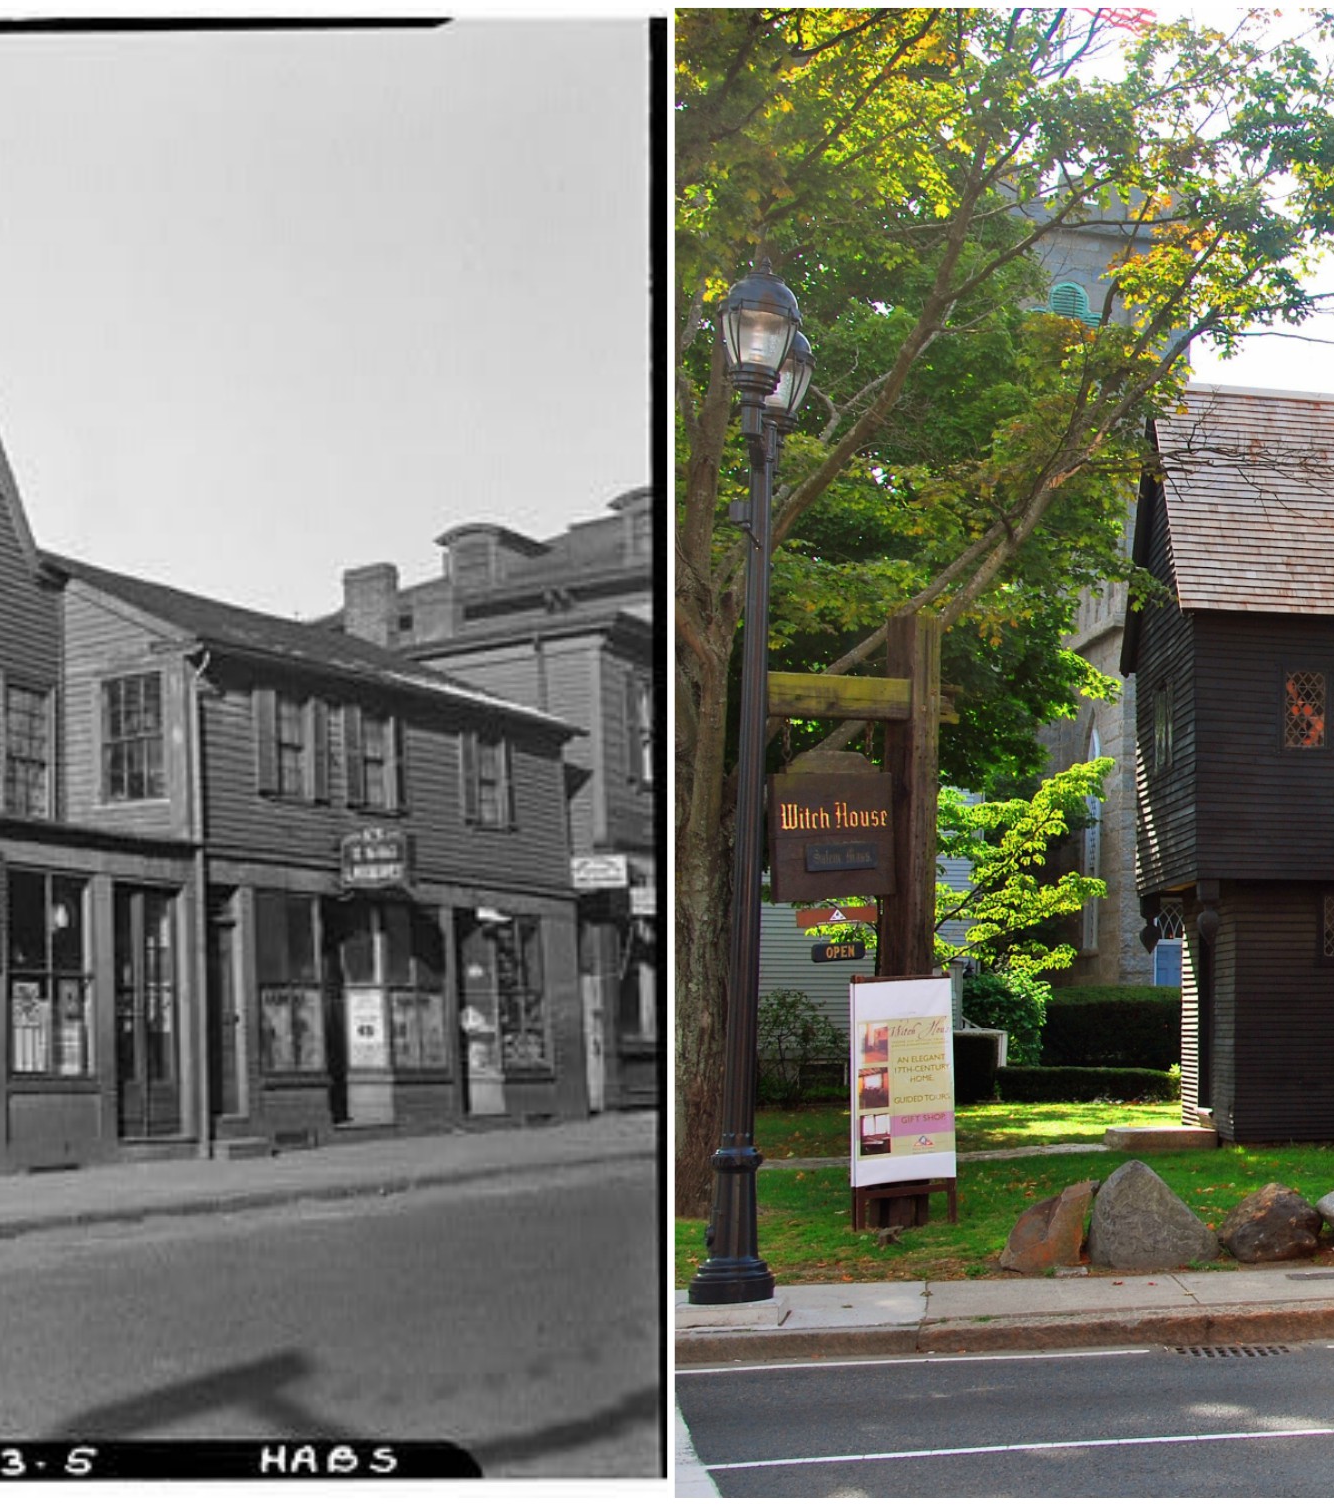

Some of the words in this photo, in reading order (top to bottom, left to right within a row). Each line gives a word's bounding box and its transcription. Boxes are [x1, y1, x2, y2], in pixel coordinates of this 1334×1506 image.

[780, 803, 830, 830] Witch
[834, 801, 888, 829] House
[826, 945, 855, 959] OPEN
[897, 1056, 909, 1064] AN
[911, 1054, 945, 1063] ELEGANT
[894, 1064, 950, 1074] 17TH-CENTURY
[894, 1095, 924, 1105] GUIDED
[901, 1115, 920, 1124] GIFT
